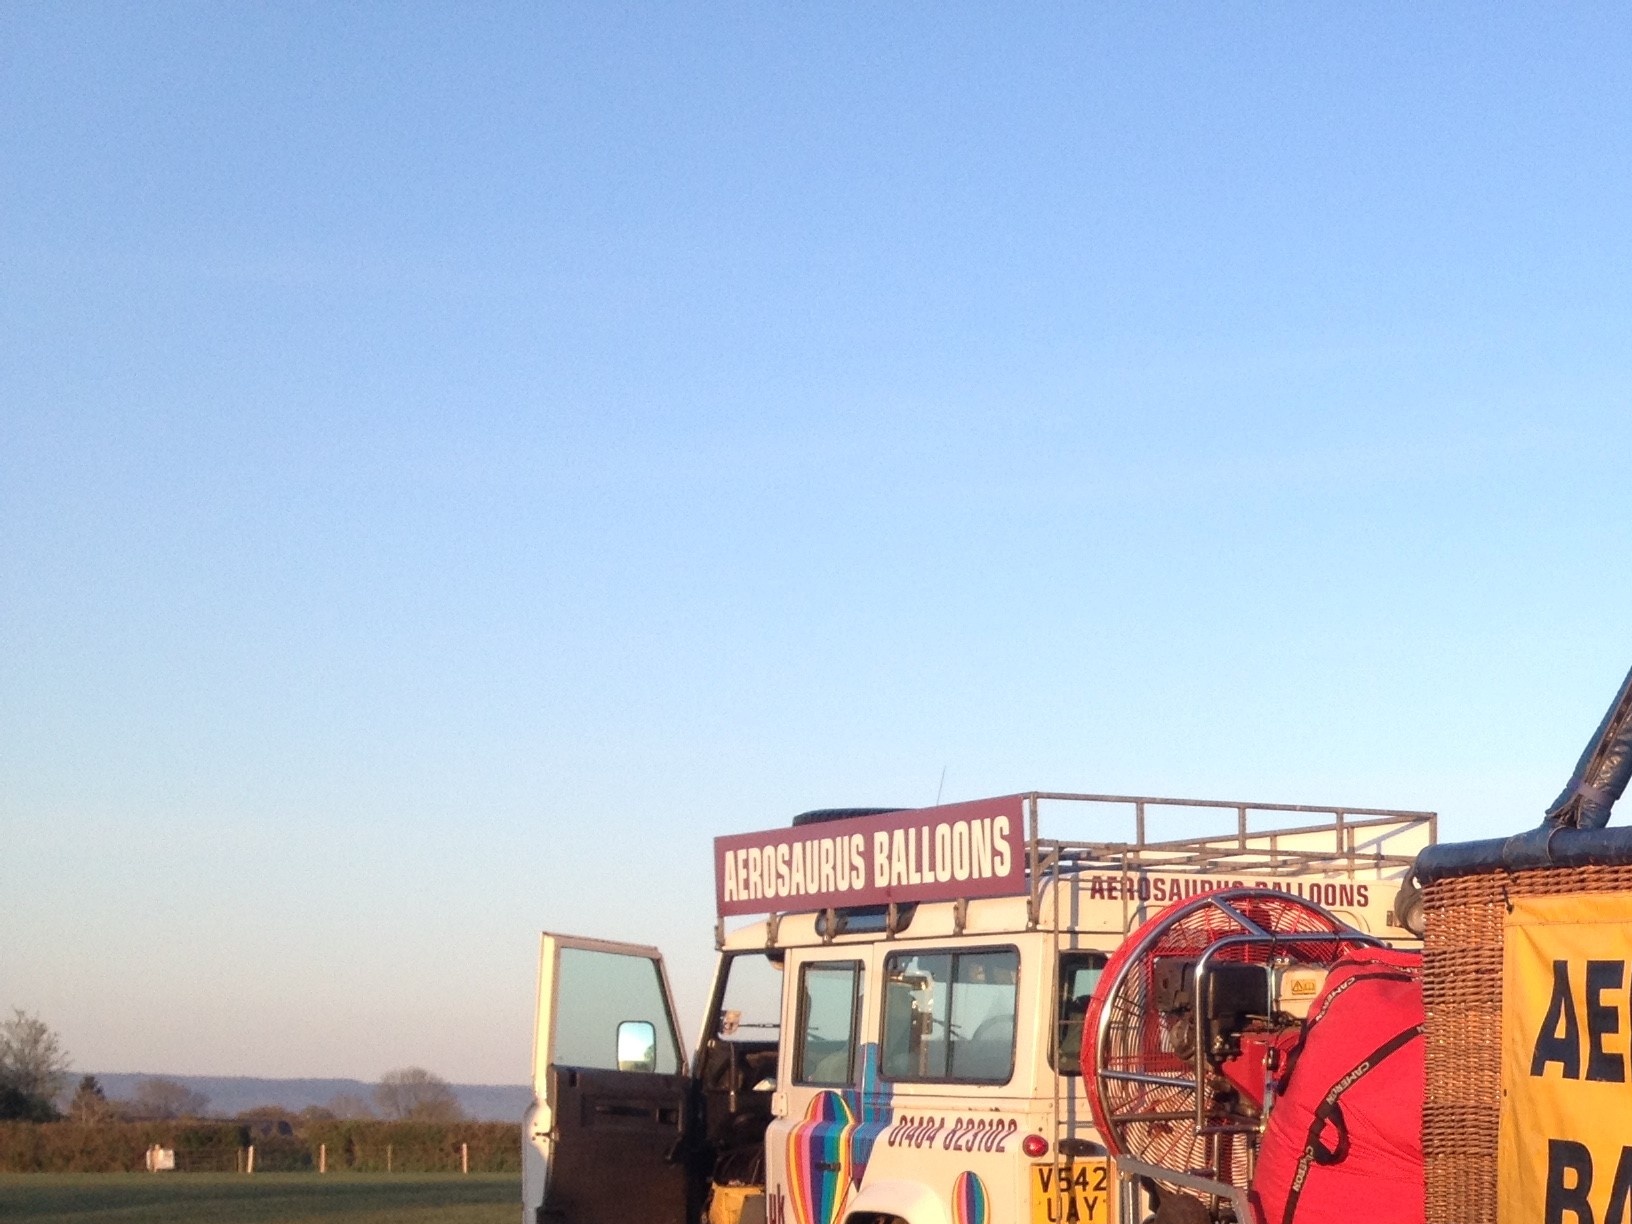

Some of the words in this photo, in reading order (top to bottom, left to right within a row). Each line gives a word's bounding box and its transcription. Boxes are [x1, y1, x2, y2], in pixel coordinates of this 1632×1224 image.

[723, 833, 866, 902] AEROSAURUS
[873, 814, 1012, 888] BALLOONS
[1325, 1061, 1371, 1106] CAMERON
[888, 1114, 945, 1150] 01404
[942, 1117, 1018, 1153] 823102
[1038, 1165, 1108, 1194] V542
[1046, 1195, 1099, 1223] UAY
